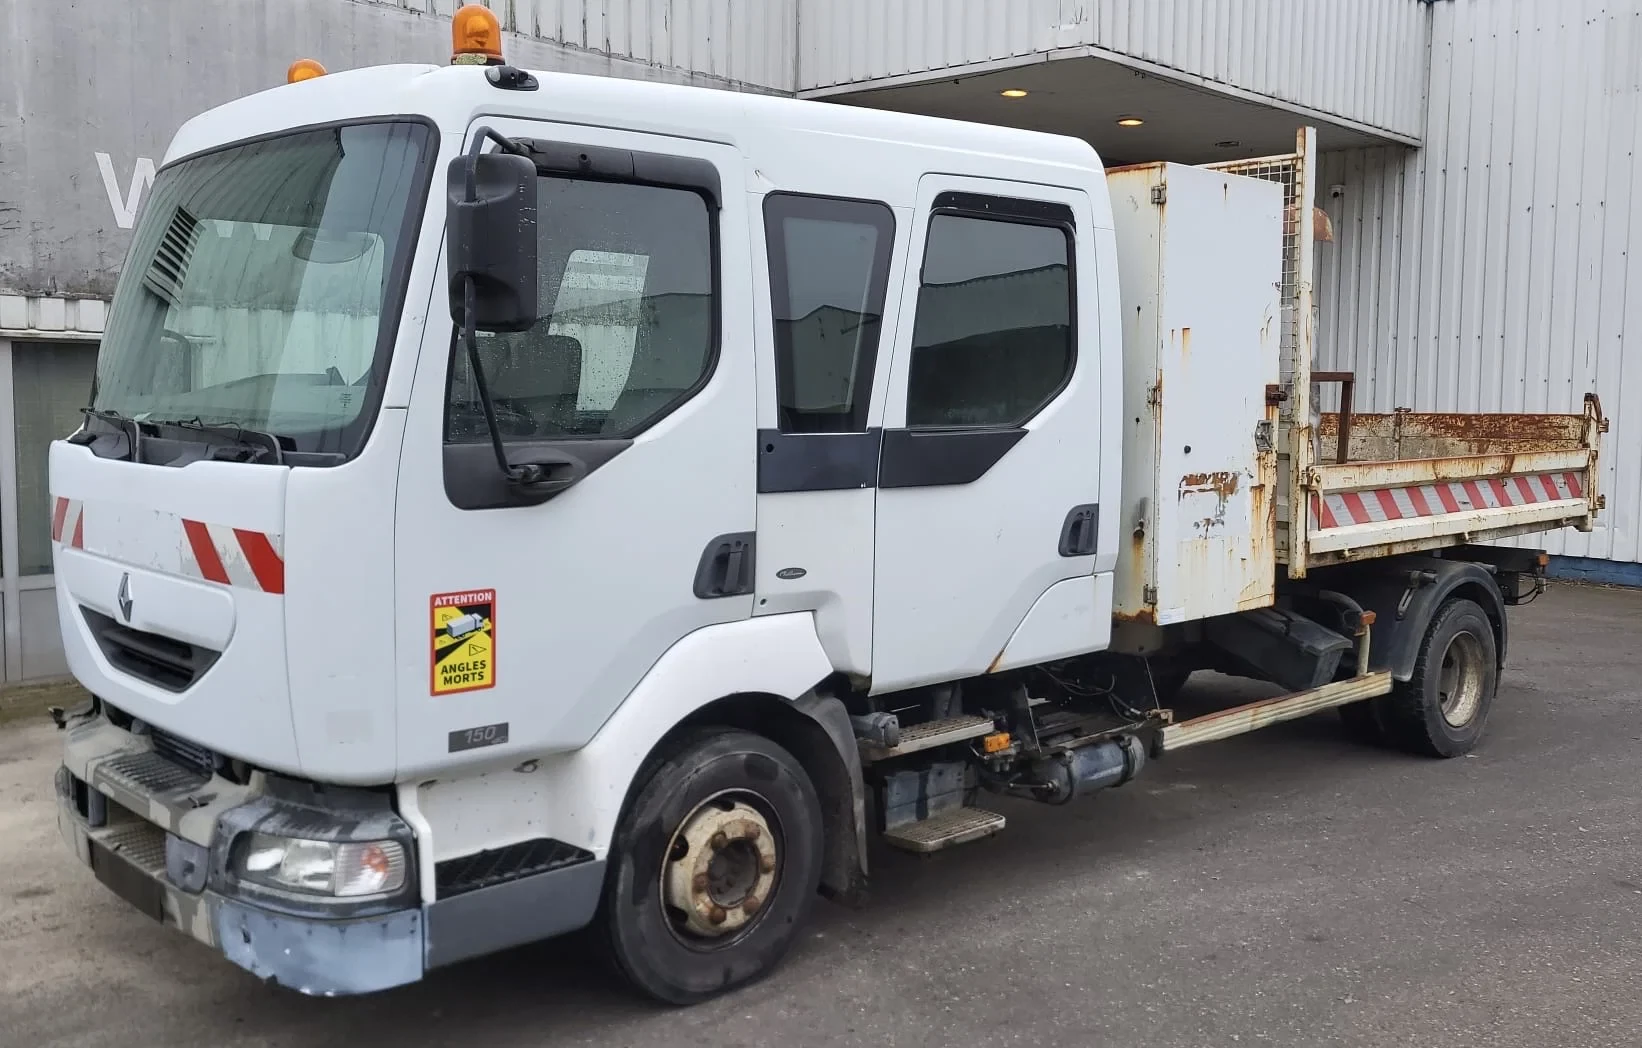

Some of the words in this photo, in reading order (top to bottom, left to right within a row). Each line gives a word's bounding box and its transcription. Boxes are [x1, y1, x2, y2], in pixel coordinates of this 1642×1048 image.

[434, 592, 492, 606] ATTENTION
[441, 660, 487, 675] ANGLES
[443, 671, 485, 686] MORTS
[464, 726, 497, 744] 150
